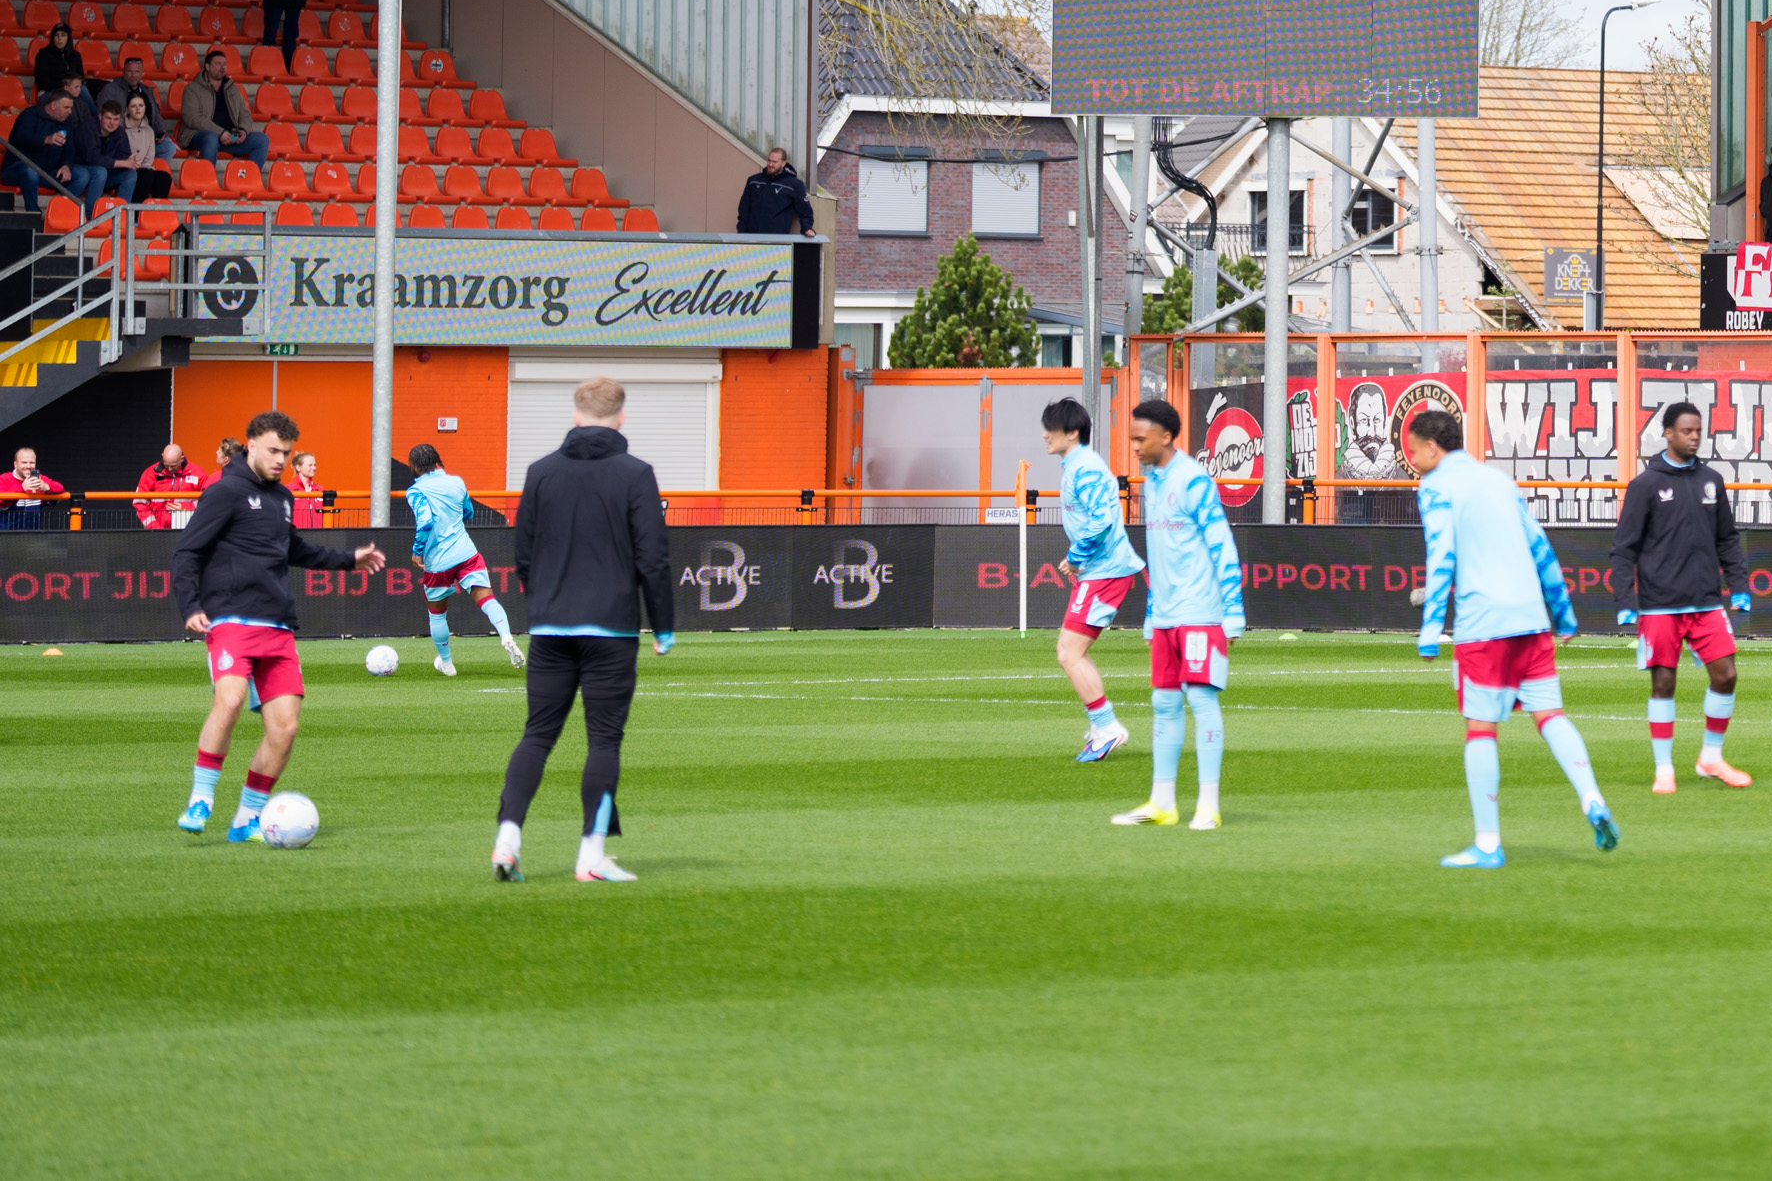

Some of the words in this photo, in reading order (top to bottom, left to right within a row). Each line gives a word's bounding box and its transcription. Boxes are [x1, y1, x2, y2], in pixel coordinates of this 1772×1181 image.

[1087, 80, 1150, 103] TOT
[1161, 80, 1199, 104] DE
[1358, 78, 1442, 104] 34:56
[290, 257, 571, 327] Kraamzorg
[595, 261, 791, 326] Excellent
[1555, 277, 1595, 291] DEKKER
[1726, 311, 1764, 330] ROBEY
[1195, 434, 1265, 480] Feyenoor
[1295, 453, 1317, 479] ZIJ
[987, 509, 1019, 518] HERAS
[0, 571, 100, 603] ORT
[304, 567, 370, 597] BIJ
[679, 565, 762, 588] ACTIVE
[813, 563, 894, 586] ACTIVE
